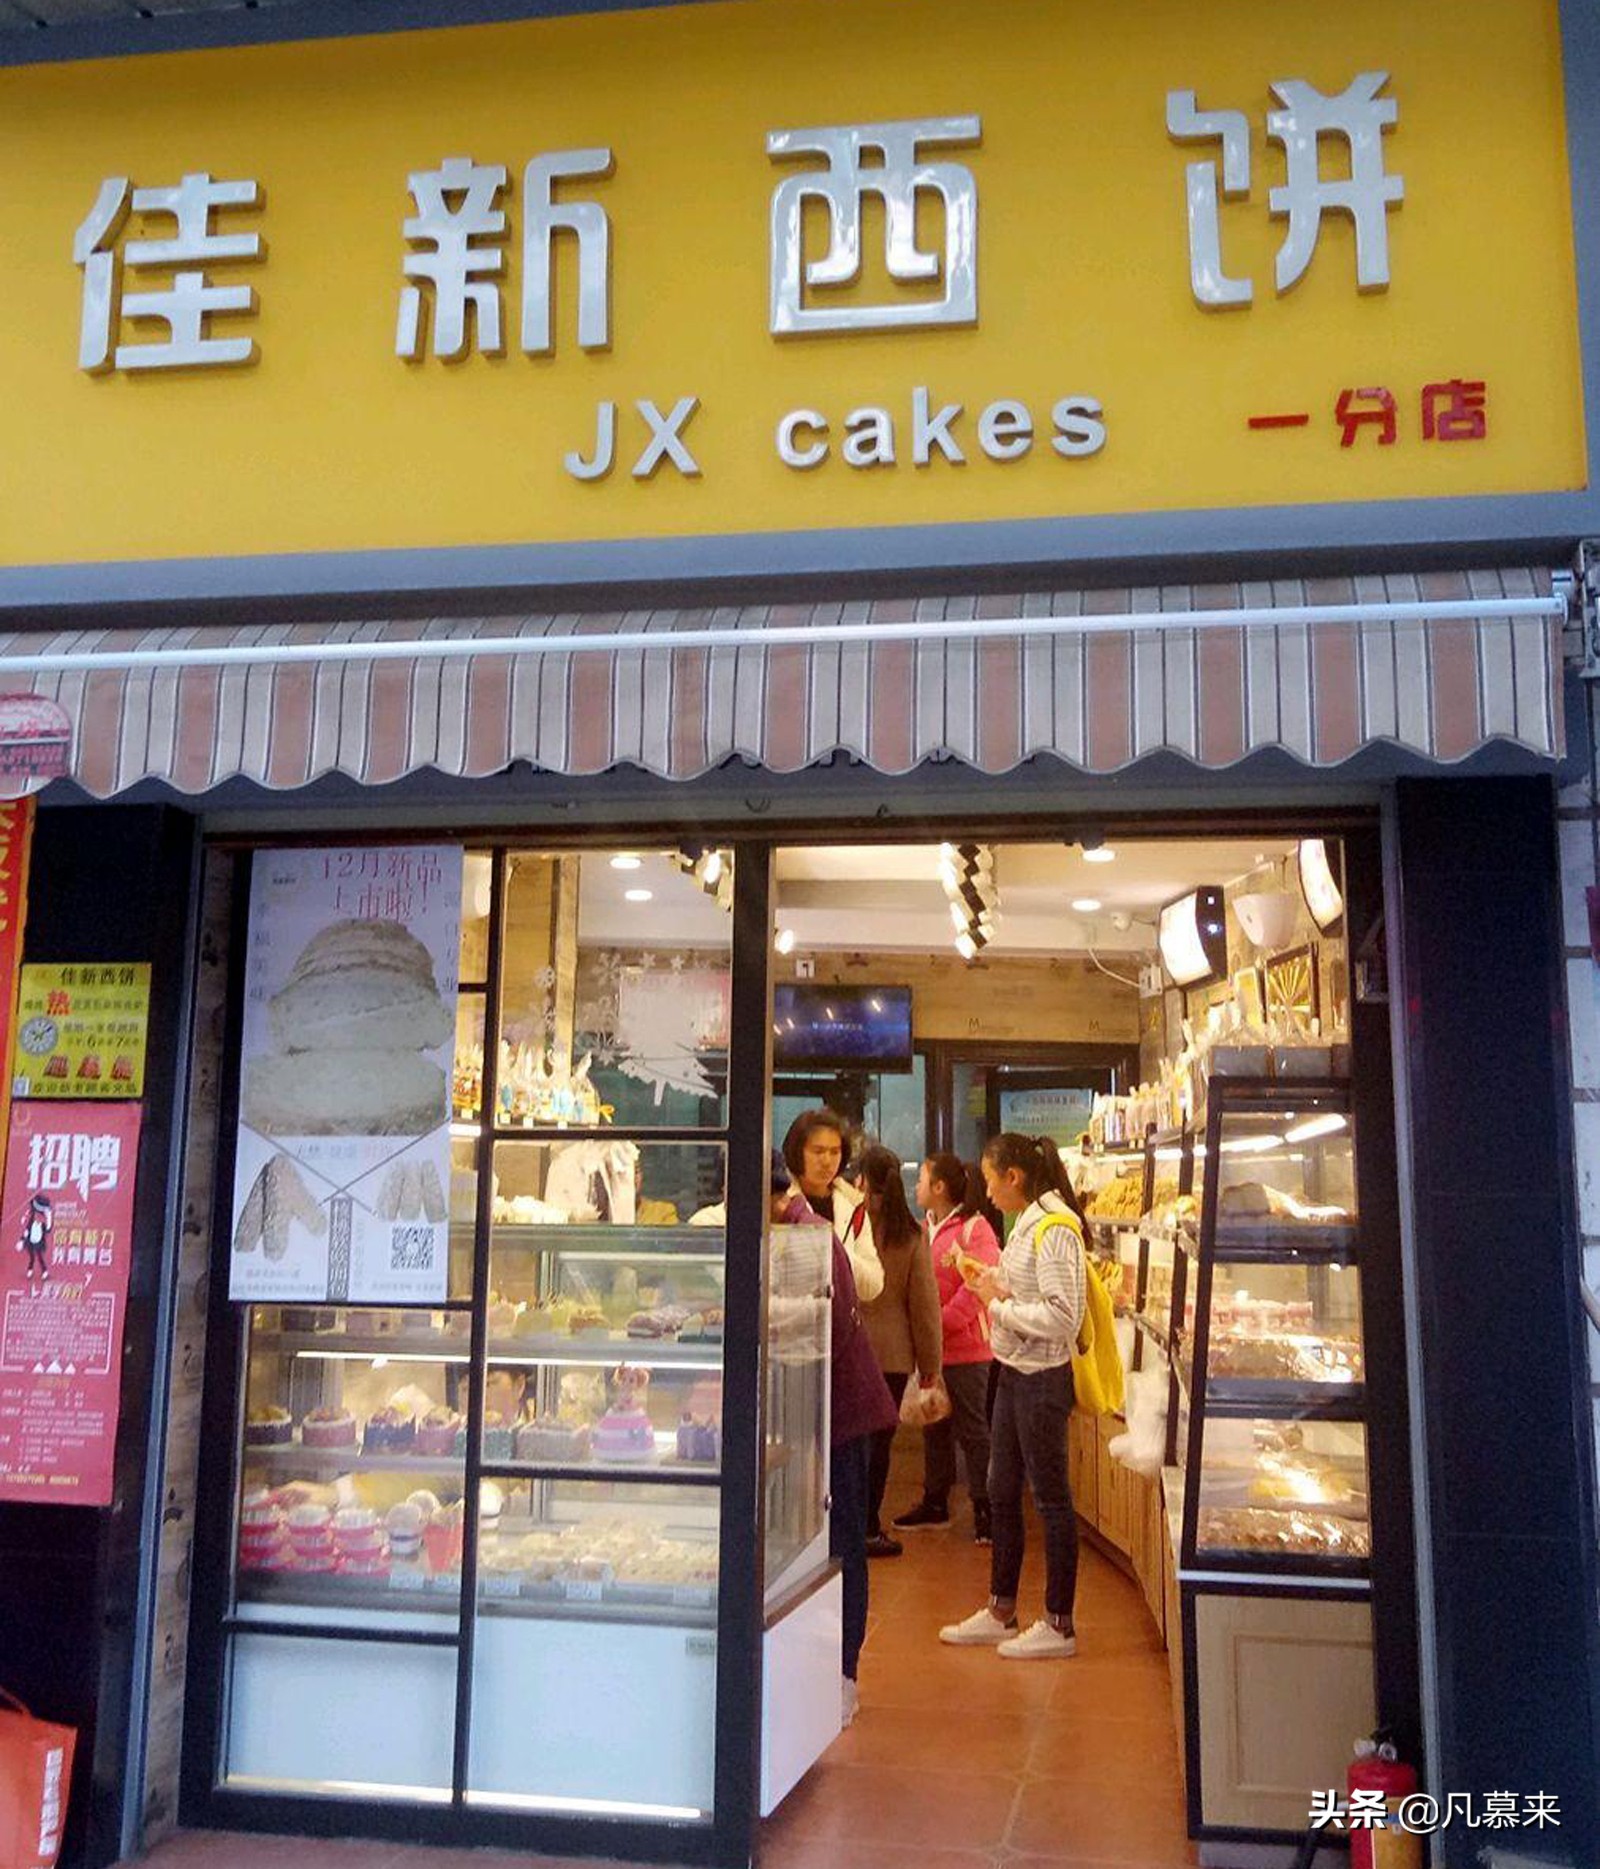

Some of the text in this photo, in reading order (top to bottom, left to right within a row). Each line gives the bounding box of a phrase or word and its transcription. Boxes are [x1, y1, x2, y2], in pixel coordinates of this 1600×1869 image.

[73, 70, 1406, 376] 佳新西饼
[564, 386, 1108, 482] JX cakes
[1248, 379, 1487, 447] 一分店
[26, 1134, 122, 1203] 招聘
